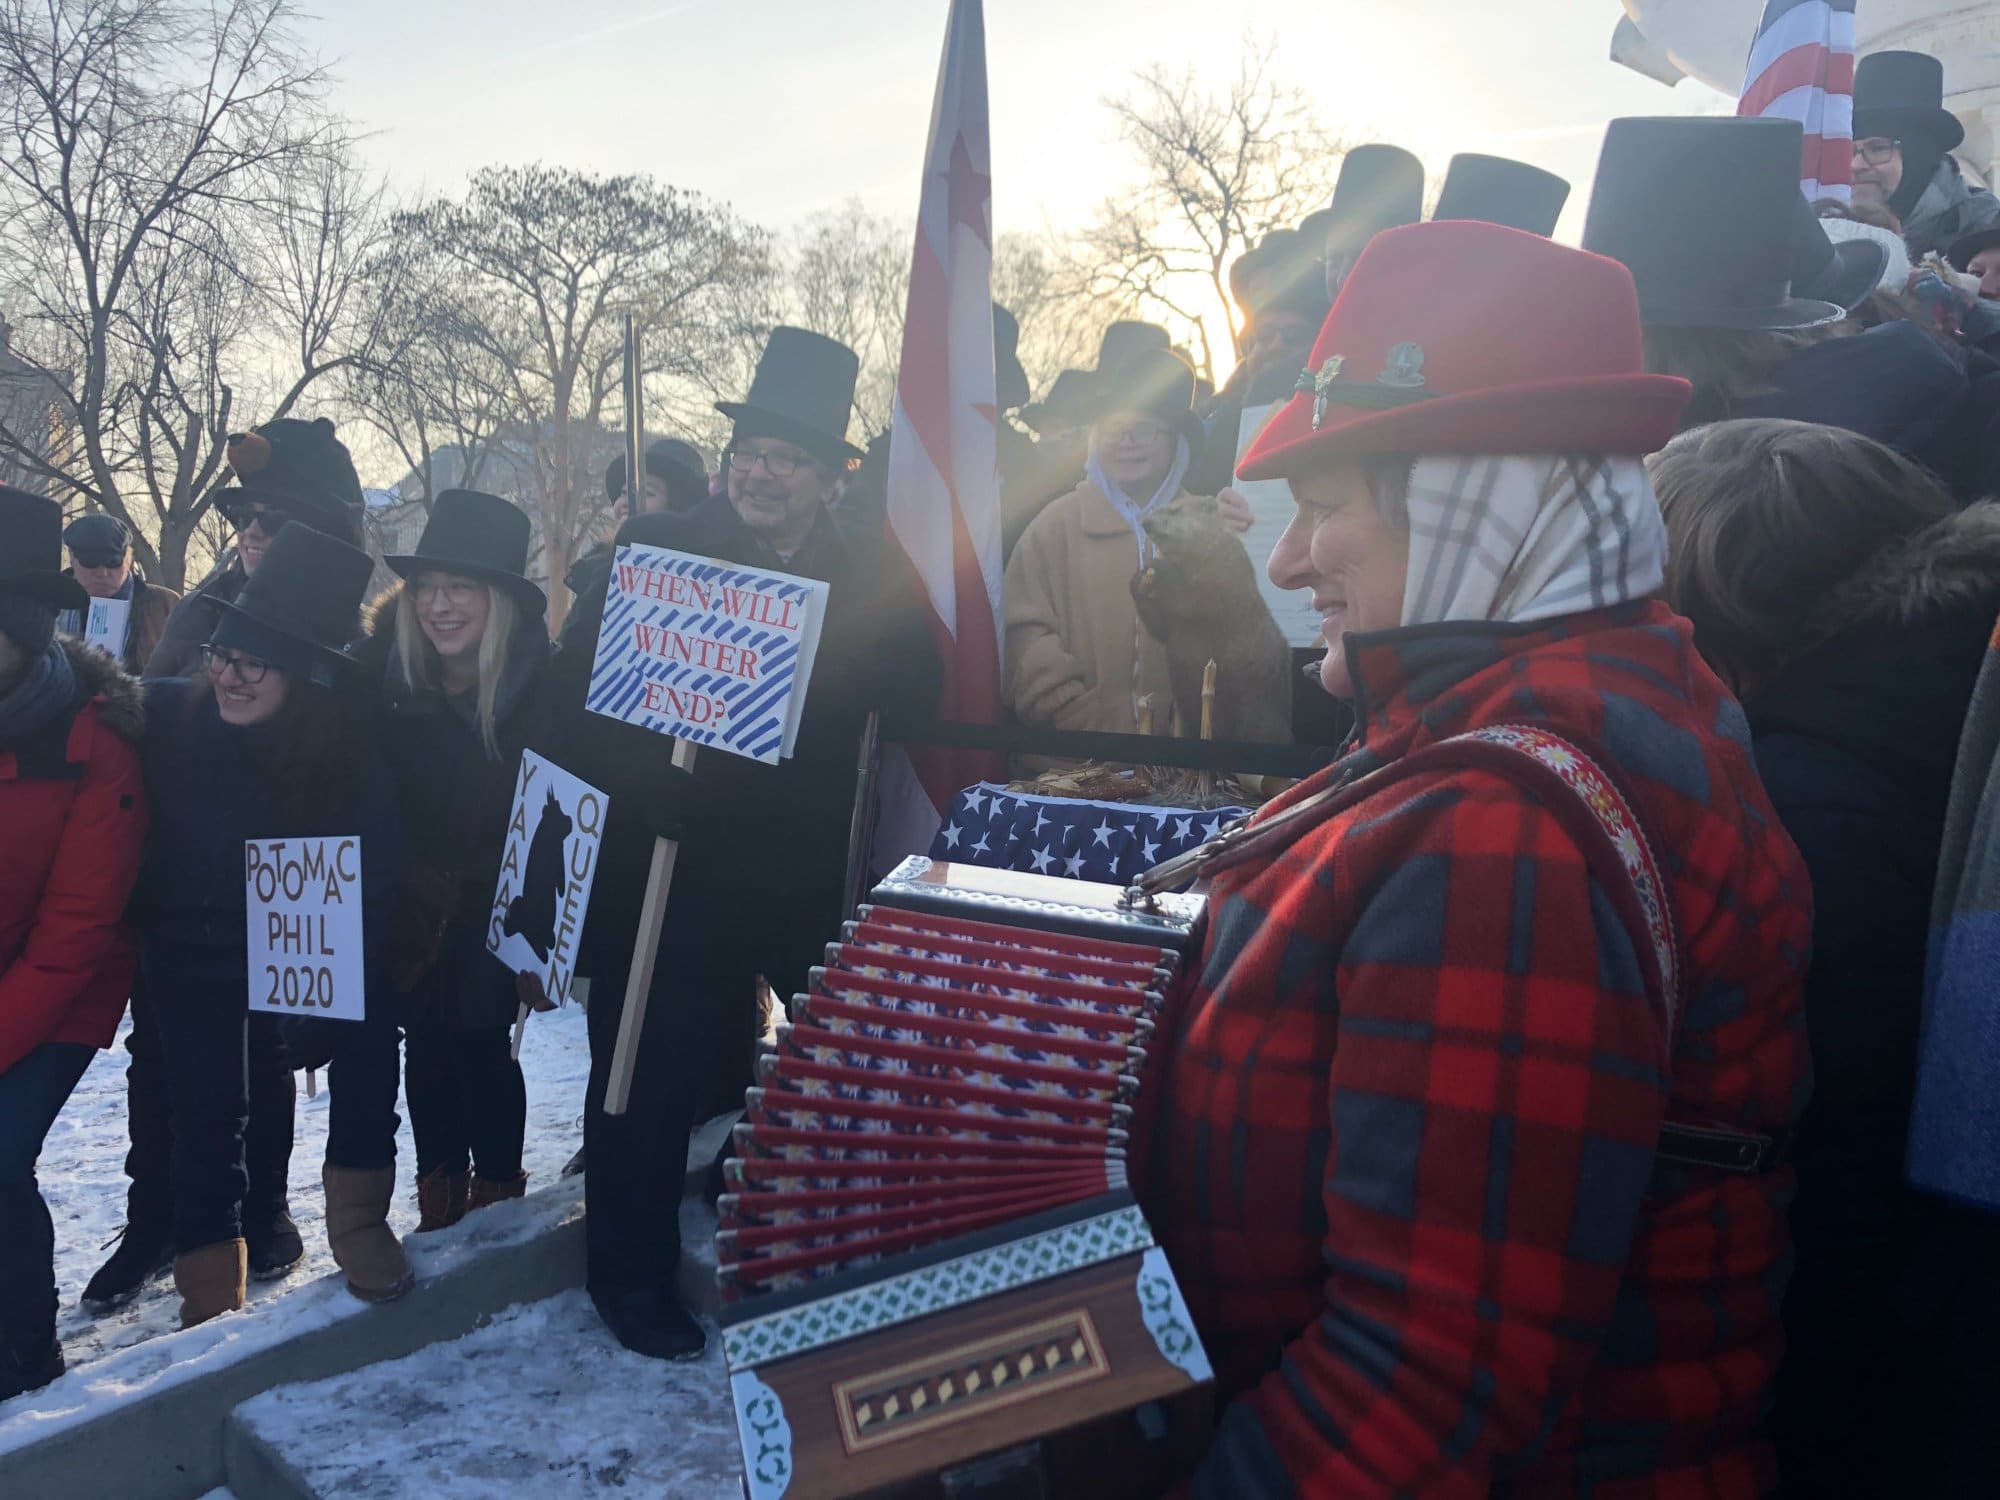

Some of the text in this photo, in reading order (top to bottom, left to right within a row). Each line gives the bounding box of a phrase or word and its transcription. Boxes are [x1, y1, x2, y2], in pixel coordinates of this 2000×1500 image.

[617, 565, 799, 631] WHEN WILL
[634, 623, 758, 680] WINTER
[642, 682, 726, 728] END?
[247, 839, 356, 905] POTOMAC
[487, 757, 538, 952] YAAAS
[546, 793, 600, 1009] QUEEN
[268, 911, 334, 956] PHIL
[266, 964, 334, 1009] 2020
